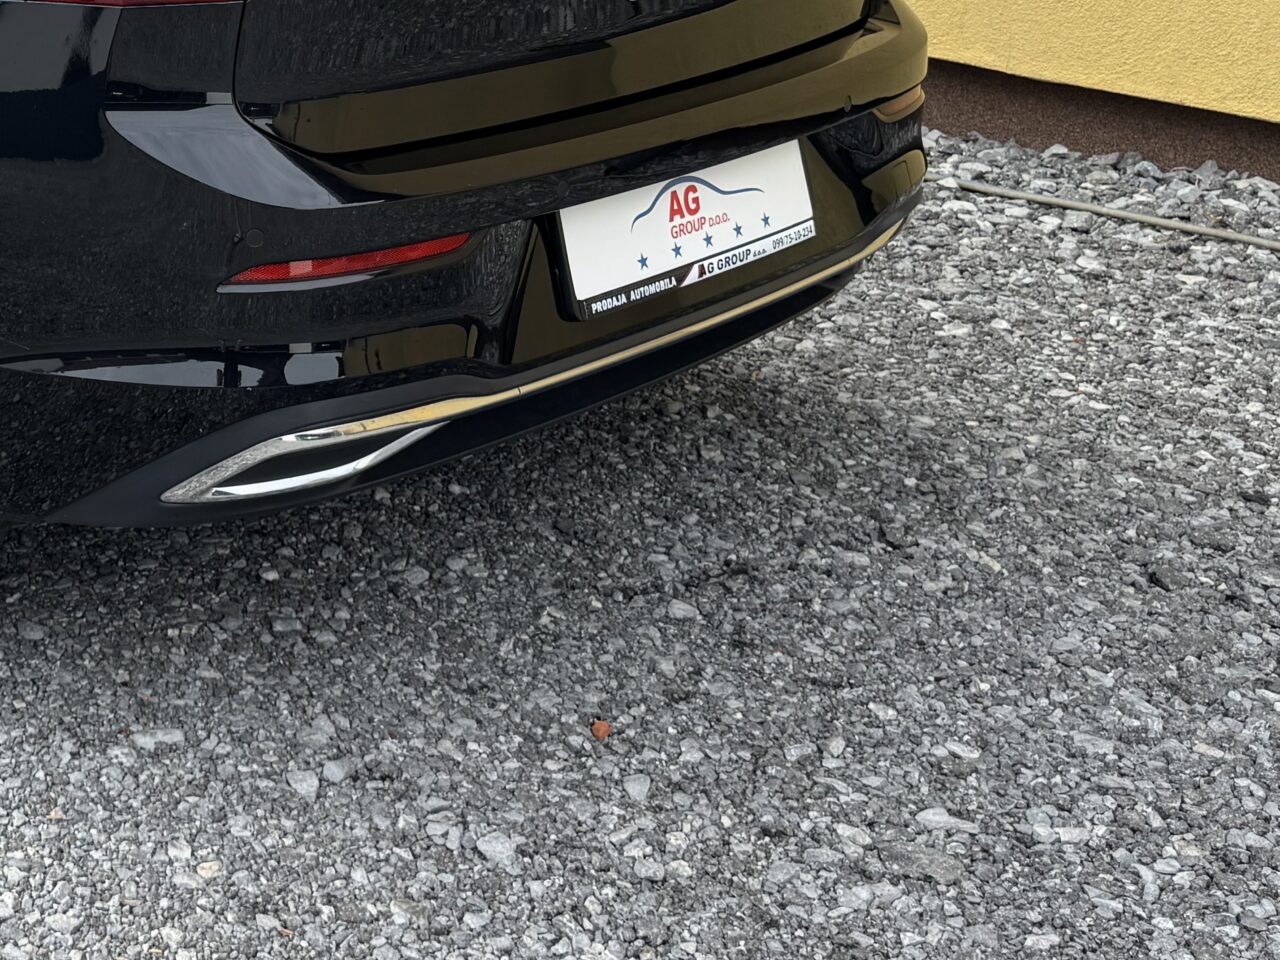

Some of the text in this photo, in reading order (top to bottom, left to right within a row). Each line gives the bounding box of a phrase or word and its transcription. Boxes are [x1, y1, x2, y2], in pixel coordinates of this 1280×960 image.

[669, 184, 701, 223] AG
[670, 212, 730, 239] GROUP D.O.O.
[697, 262, 715, 279] AG
[717, 248, 751, 271] GROUP
[591, 276, 677, 314] PRODAJA AUTOMOBILA
